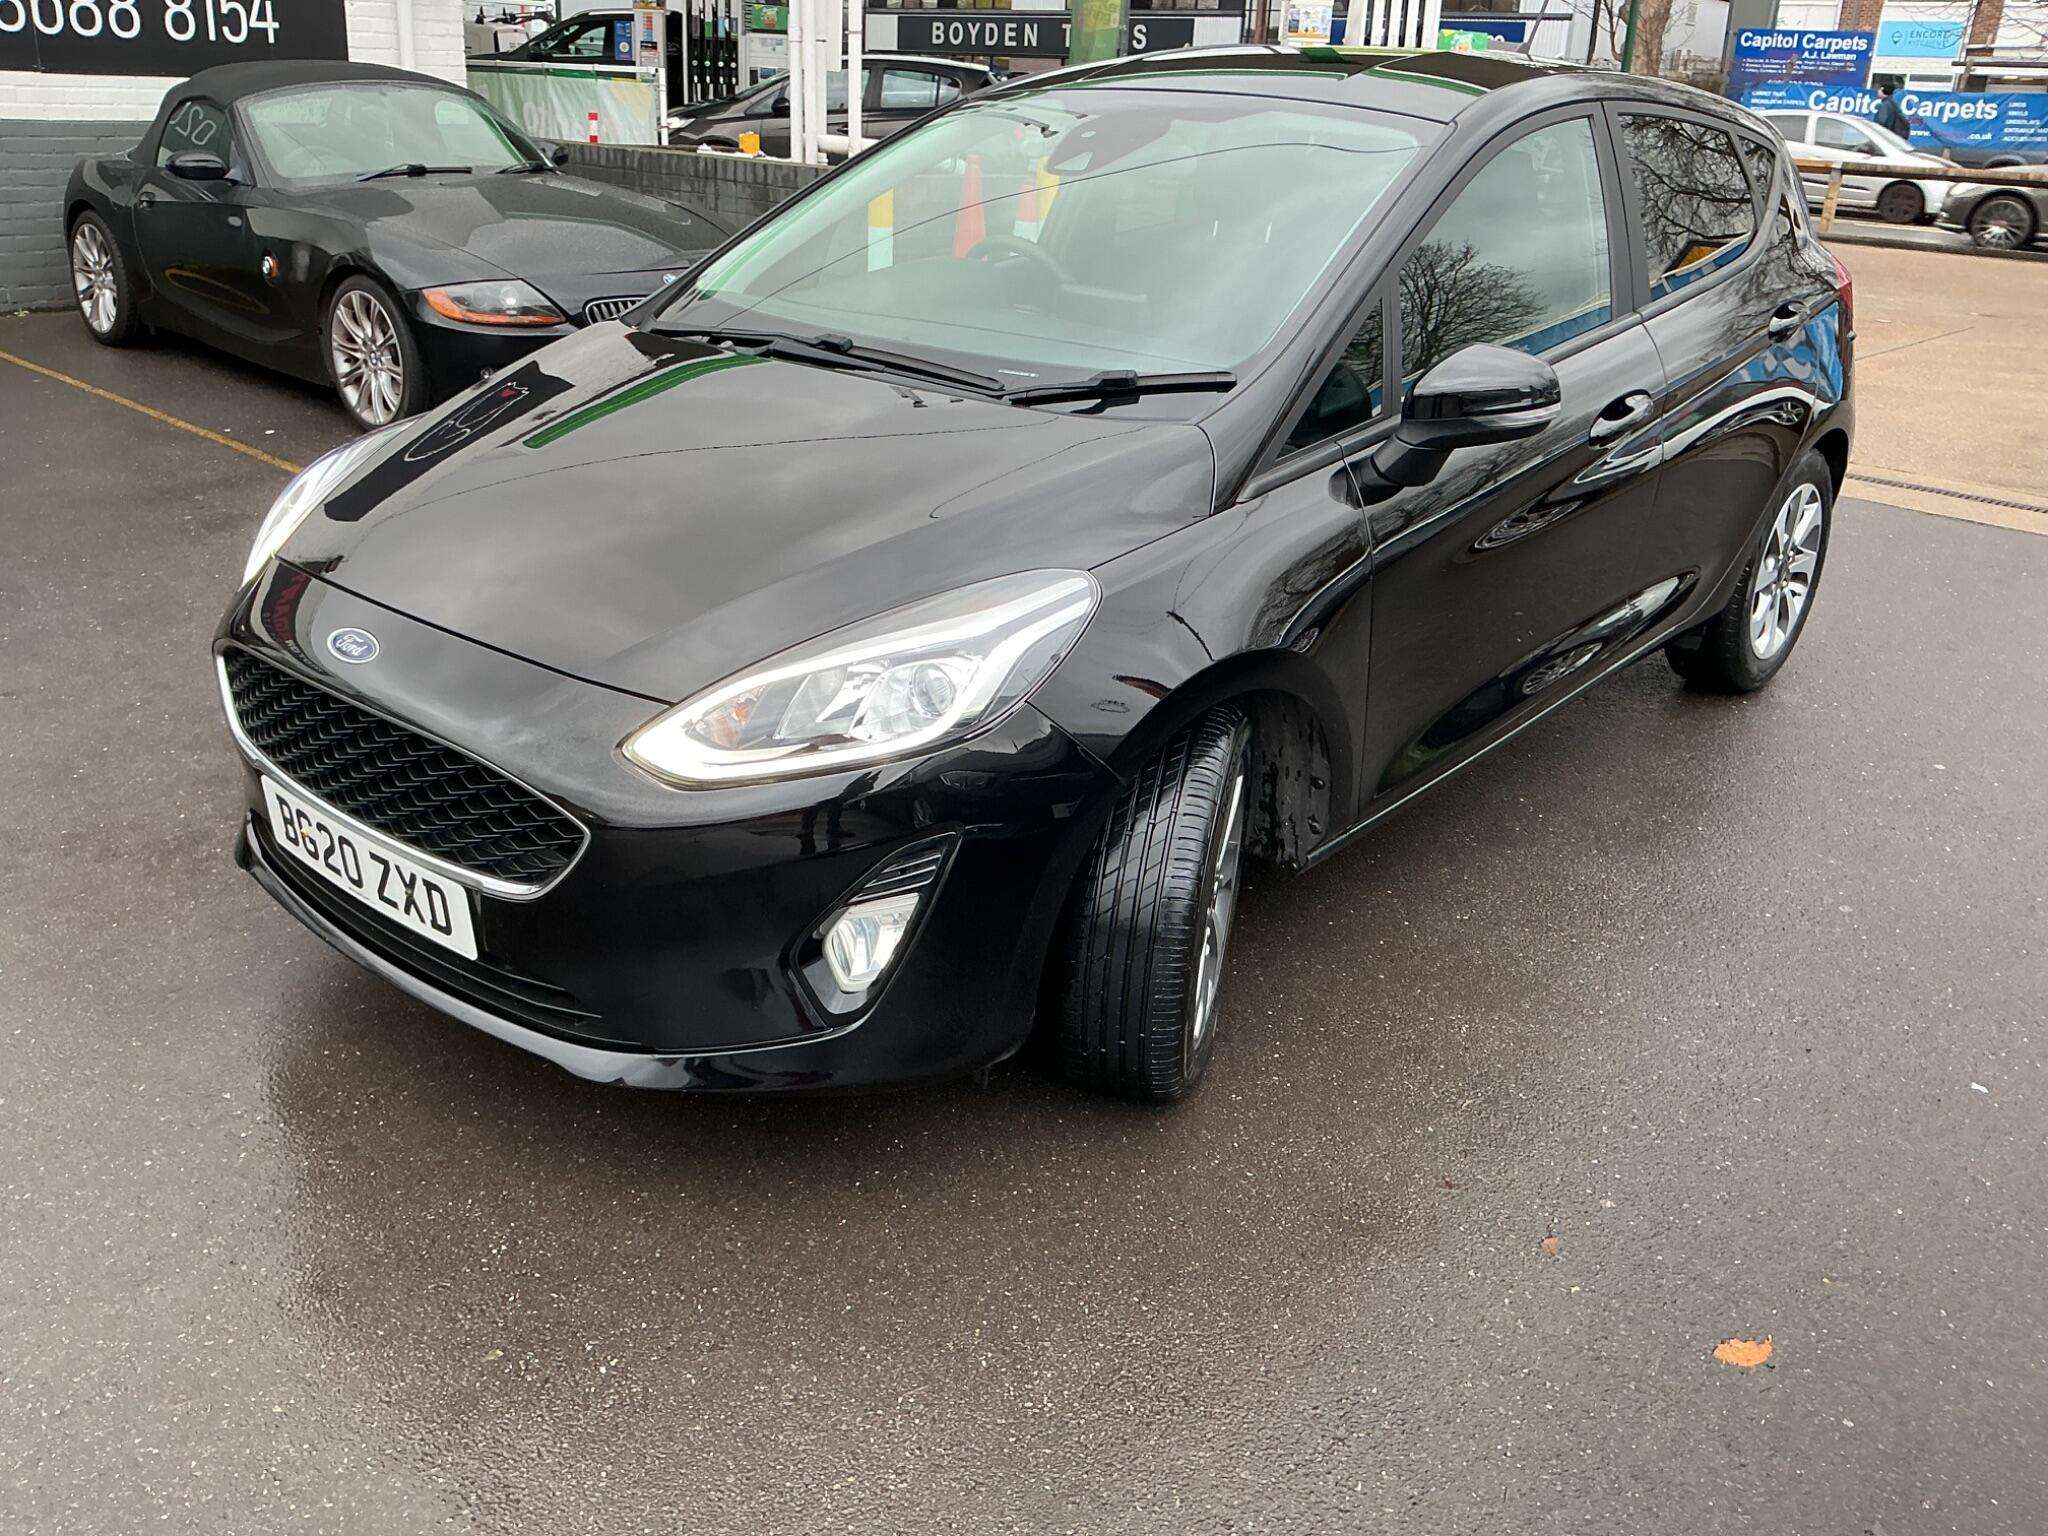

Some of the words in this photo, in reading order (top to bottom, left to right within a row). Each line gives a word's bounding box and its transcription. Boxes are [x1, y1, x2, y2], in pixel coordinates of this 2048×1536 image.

[164, 0, 280, 44] 8154
[931, 22, 1038, 47] BOYDEN
[1740, 31, 1798, 50] Capitol
[1802, 33, 1868, 52] Carpets
[1900, 94, 1999, 123] Carpets
[335, 634, 369, 656] Ford
[275, 793, 364, 890] BG20
[369, 850, 453, 937] ZXD
